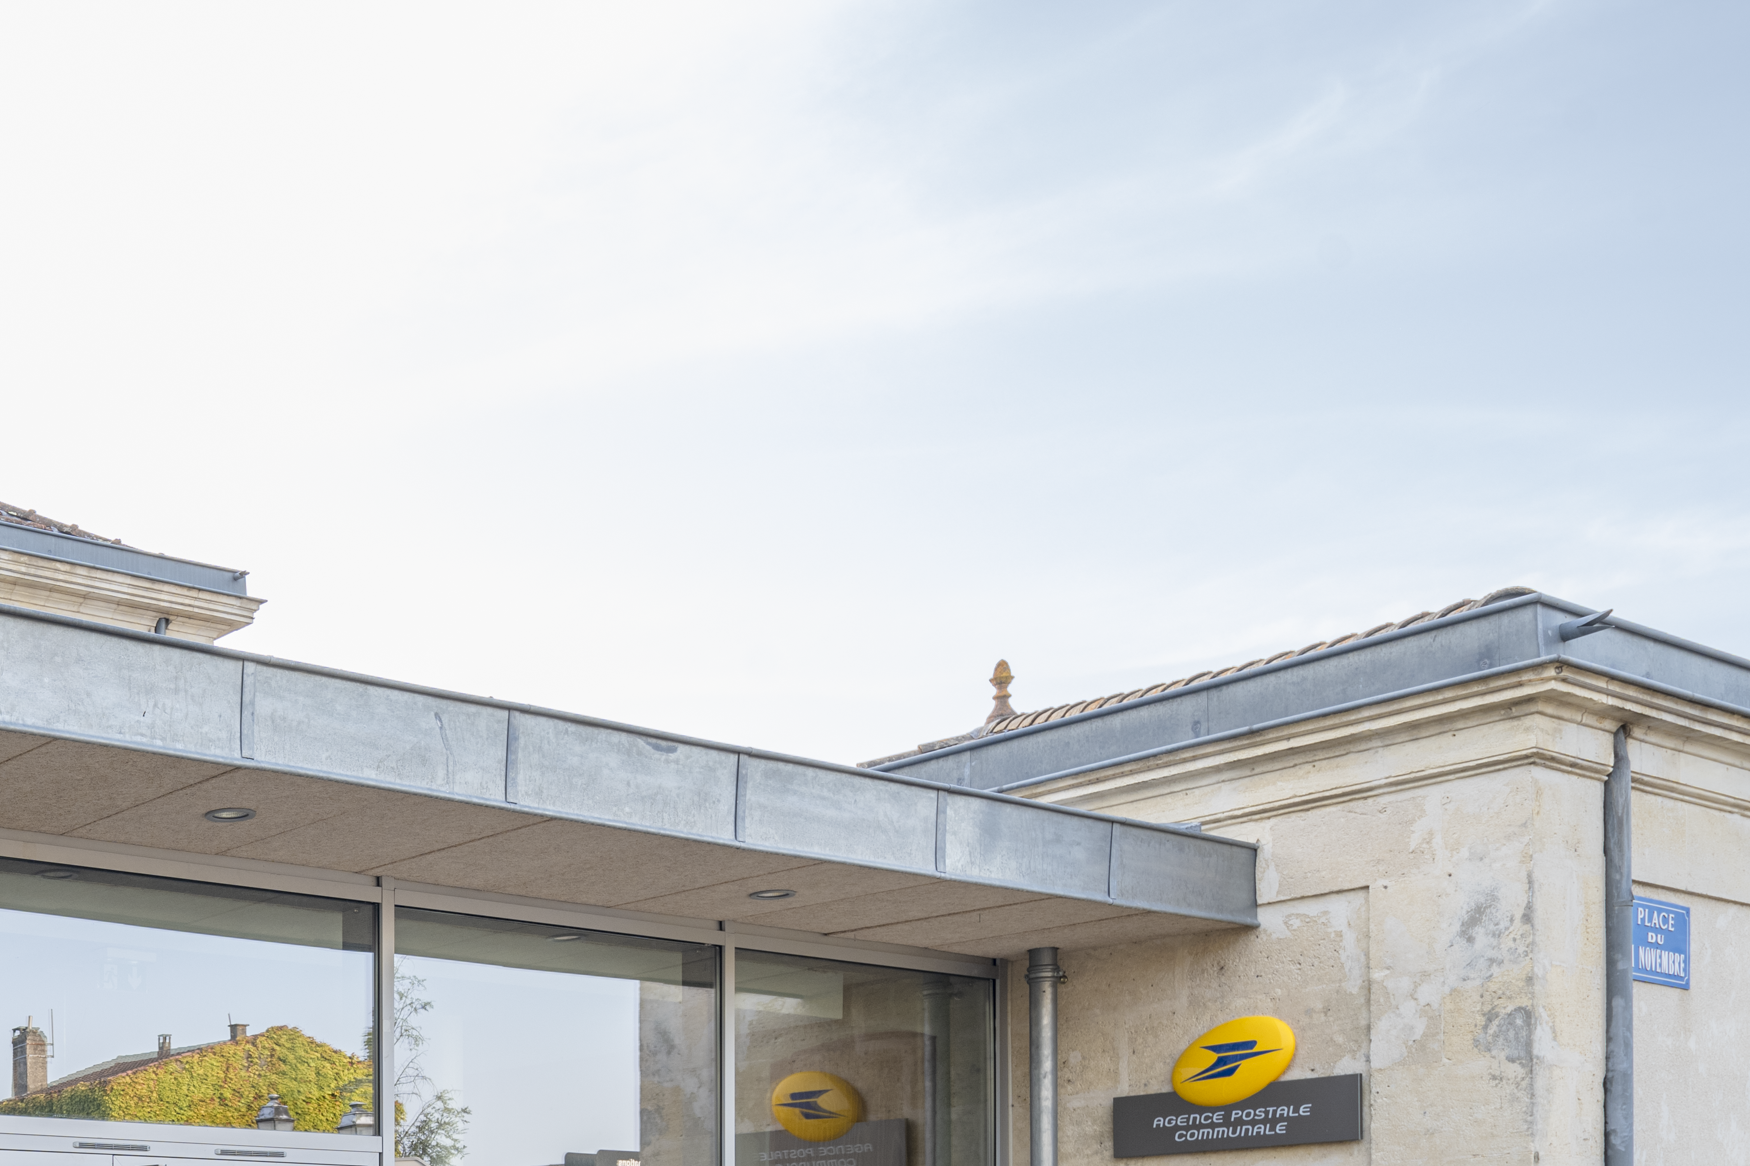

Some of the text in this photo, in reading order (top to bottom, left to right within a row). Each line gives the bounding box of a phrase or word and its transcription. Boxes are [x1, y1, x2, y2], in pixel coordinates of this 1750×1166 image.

[1637, 907, 1675, 932] PLACE
[1647, 932, 1665, 945] DU
[1638, 945, 1685, 978] NOVEMBRE
[1153, 1103, 1312, 1128] AGENCE POSTALE
[1174, 1121, 1288, 1142] COMMUNALE
